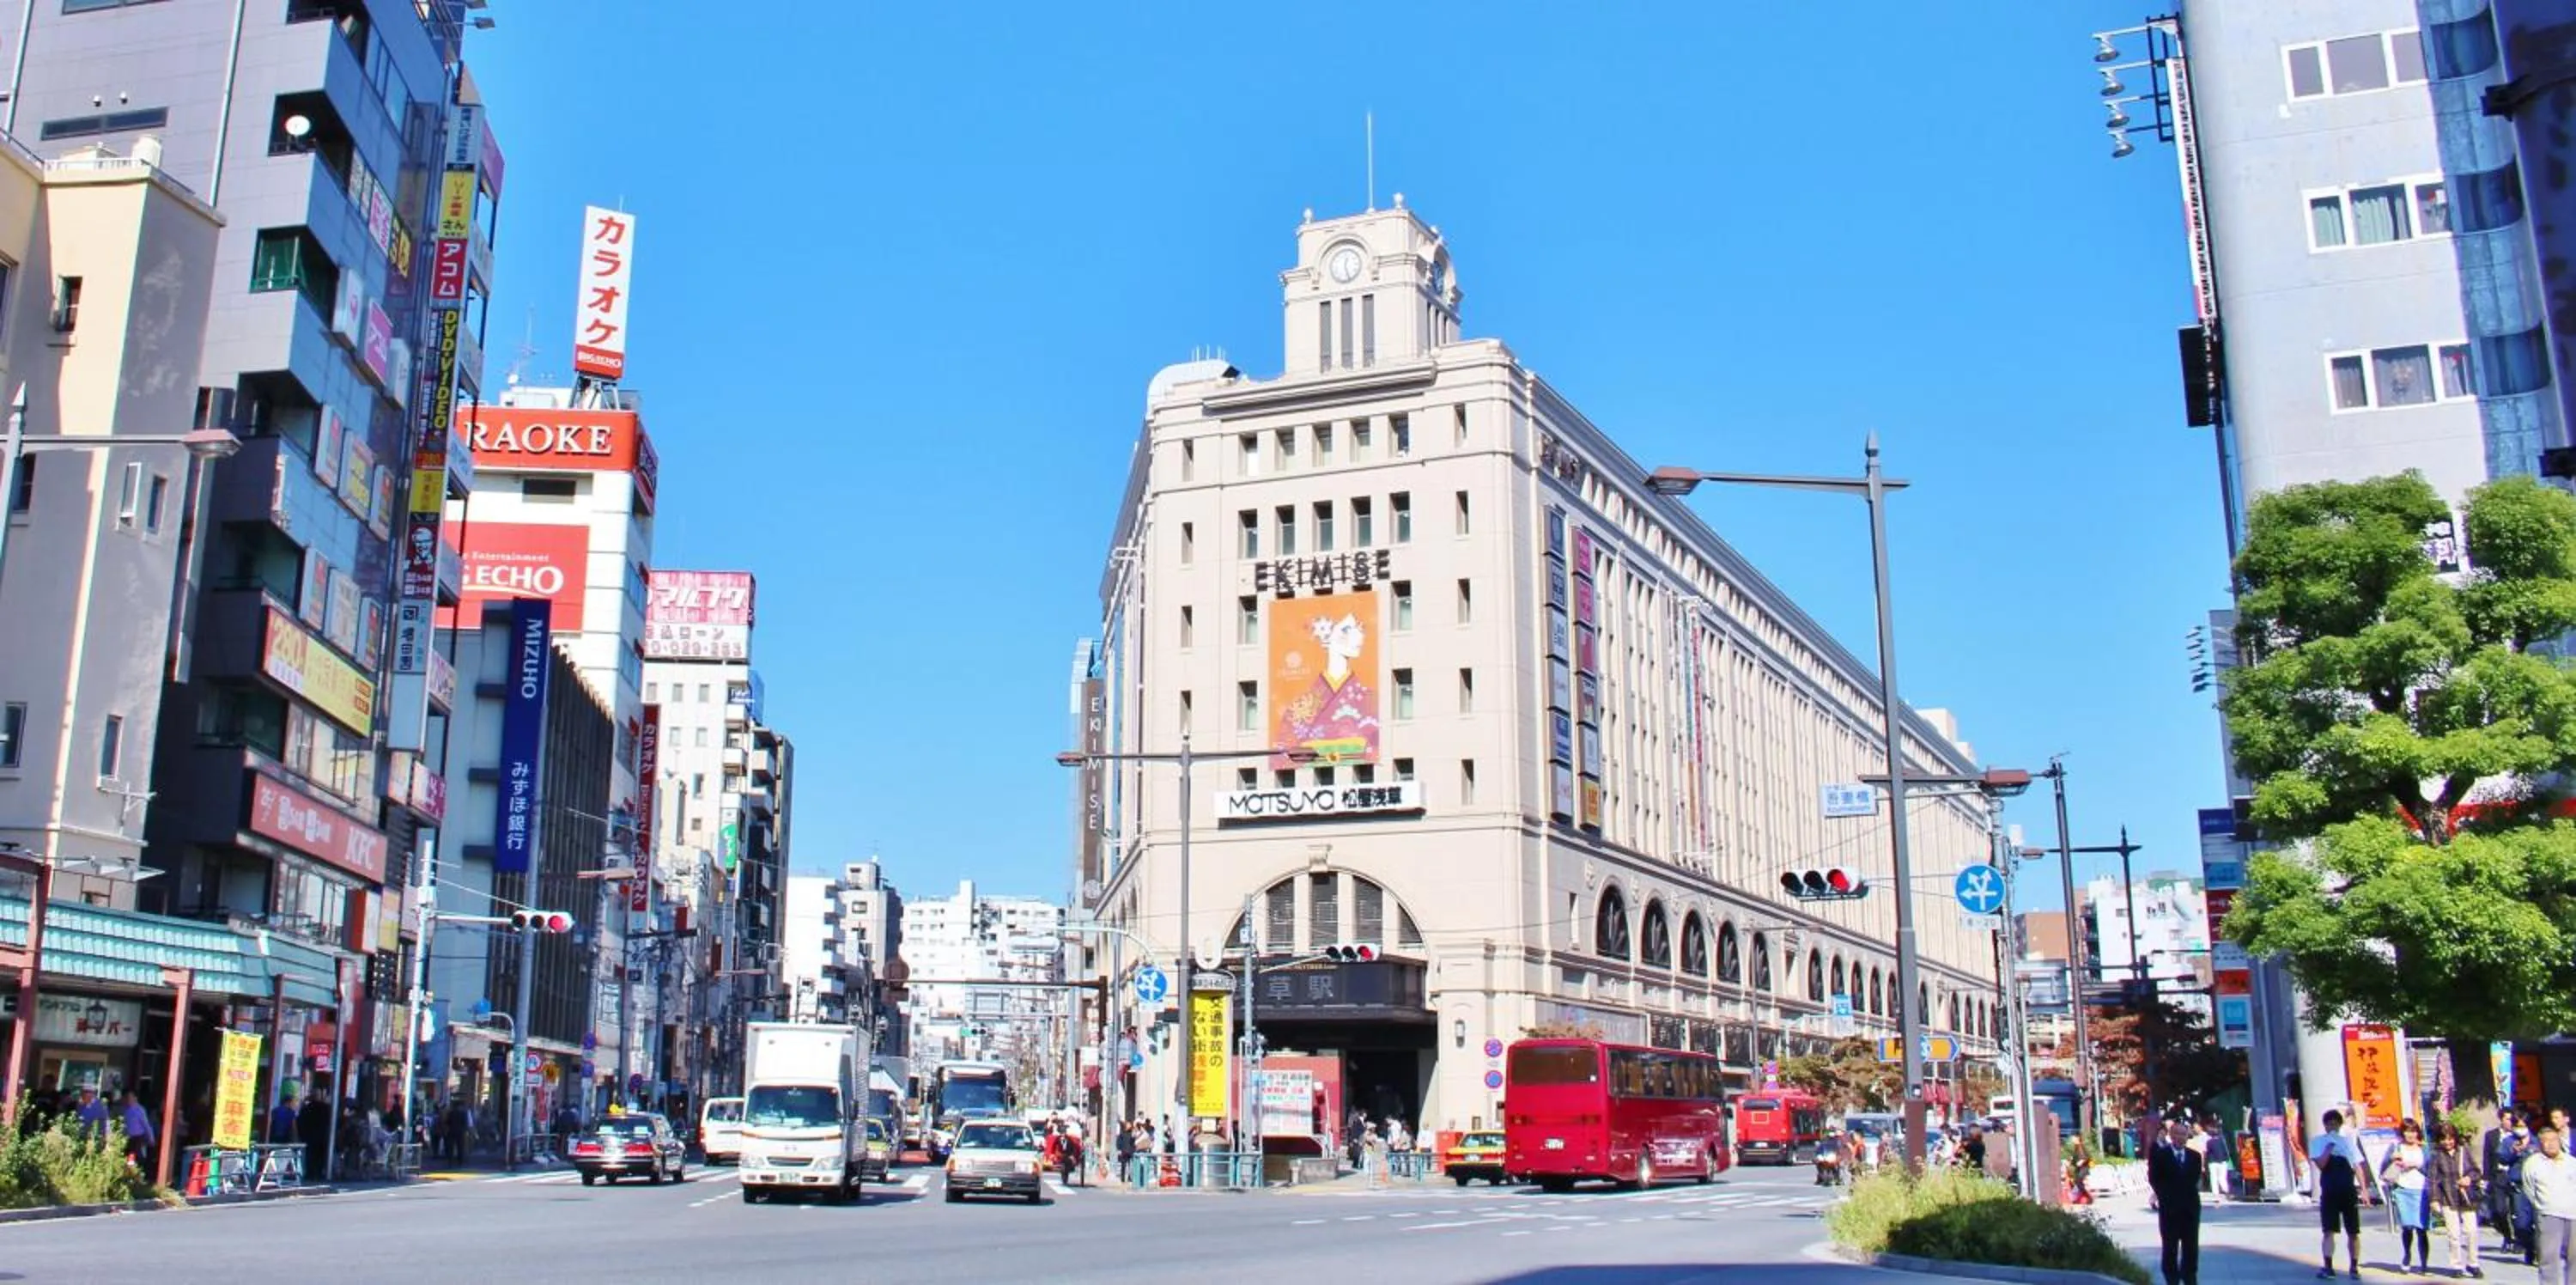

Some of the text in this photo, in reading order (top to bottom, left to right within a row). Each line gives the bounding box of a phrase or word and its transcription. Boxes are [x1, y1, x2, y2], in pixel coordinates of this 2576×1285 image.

[439, 243, 461, 295] アコム
[585, 216, 626, 344] カラオケ
[464, 421, 612, 454] RAOKE
[476, 565, 564, 594] ECHO
[1255, 550, 1390, 593] EKIMISE
[521, 618, 543, 699] MIZUHO
[1088, 697, 1102, 830] EKIMISE
[507, 761, 530, 850] みずほ銀行
[1229, 786, 1402, 815] MATSUYA 松屋浅草
[345, 825, 378, 870] KFC
[1242, 975, 1334, 1001] 草駅
